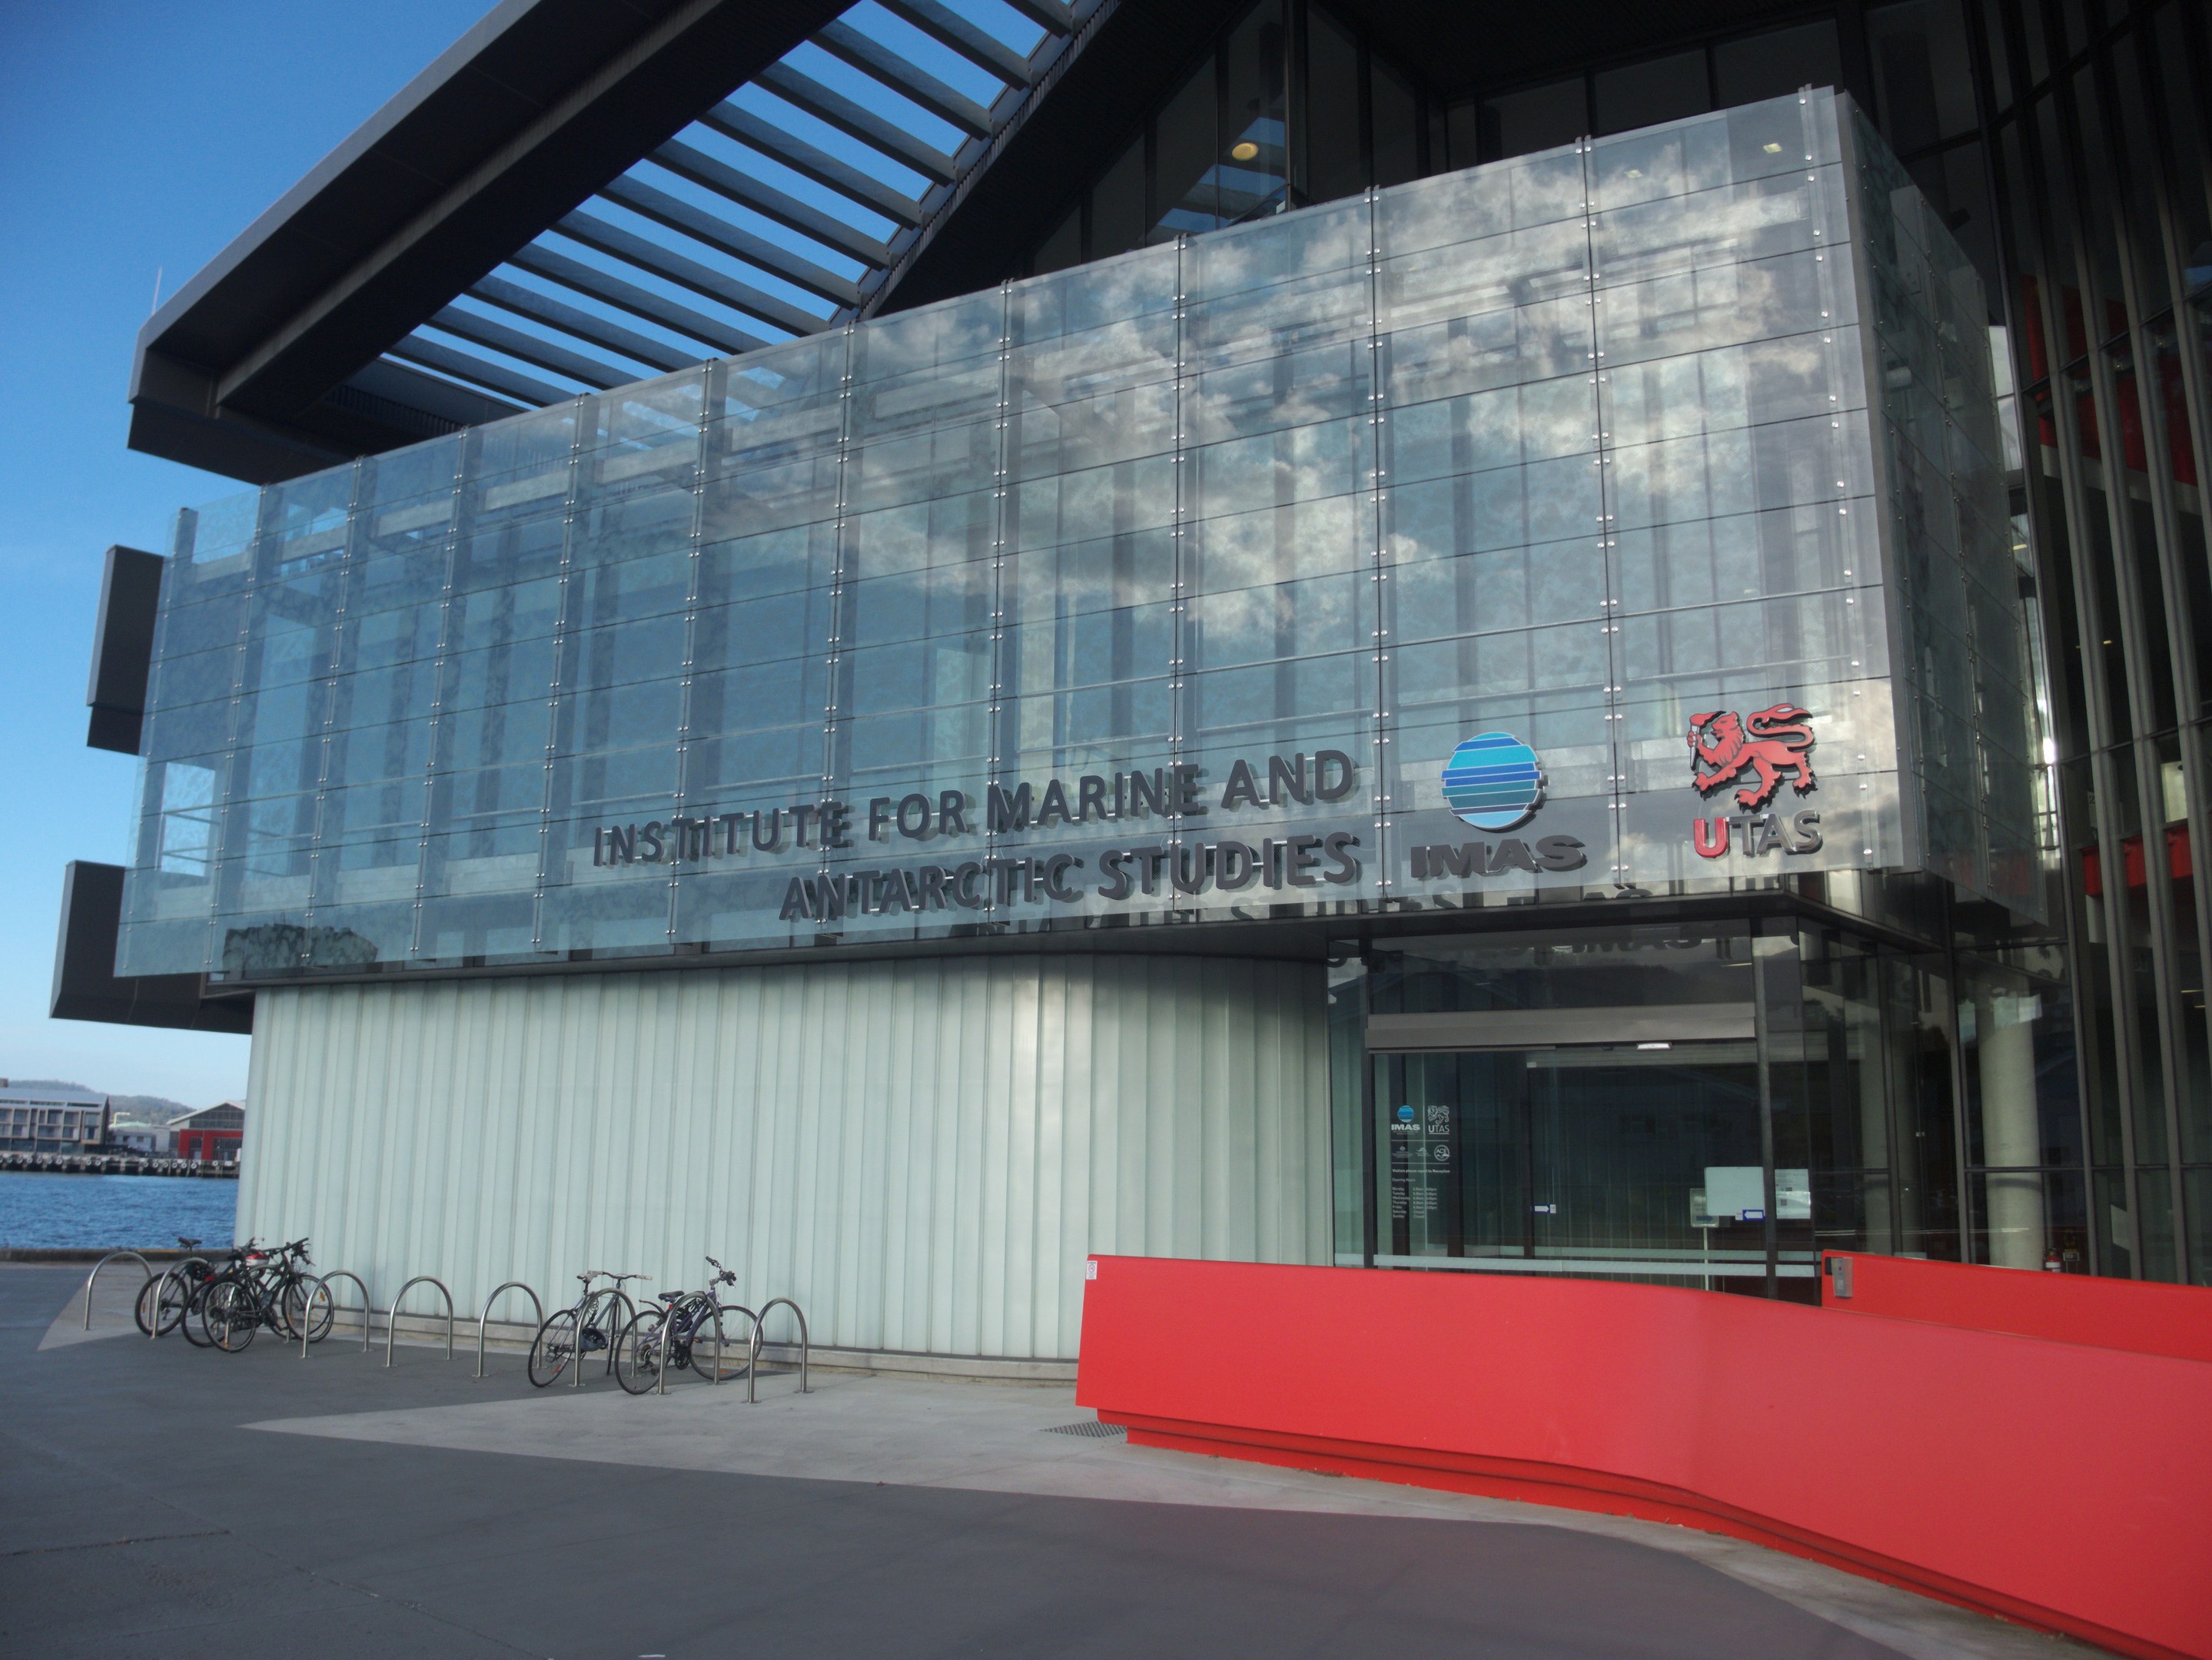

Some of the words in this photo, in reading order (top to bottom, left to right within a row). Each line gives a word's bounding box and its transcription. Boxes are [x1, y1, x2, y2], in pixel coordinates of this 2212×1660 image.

[593, 802, 844, 867] INSTITUTE
[869, 789, 968, 841] FOR
[987, 764, 1201, 830] MARINE
[1221, 749, 1354, 808] AND
[1410, 835, 1586, 878] IMAS
[1693, 810, 1822, 858] UTAS
[779, 854, 1078, 921] ANTARCTIC
[1098, 832, 1357, 899] STUDIES
[1428, 1124, 1450, 1133] UTAS
